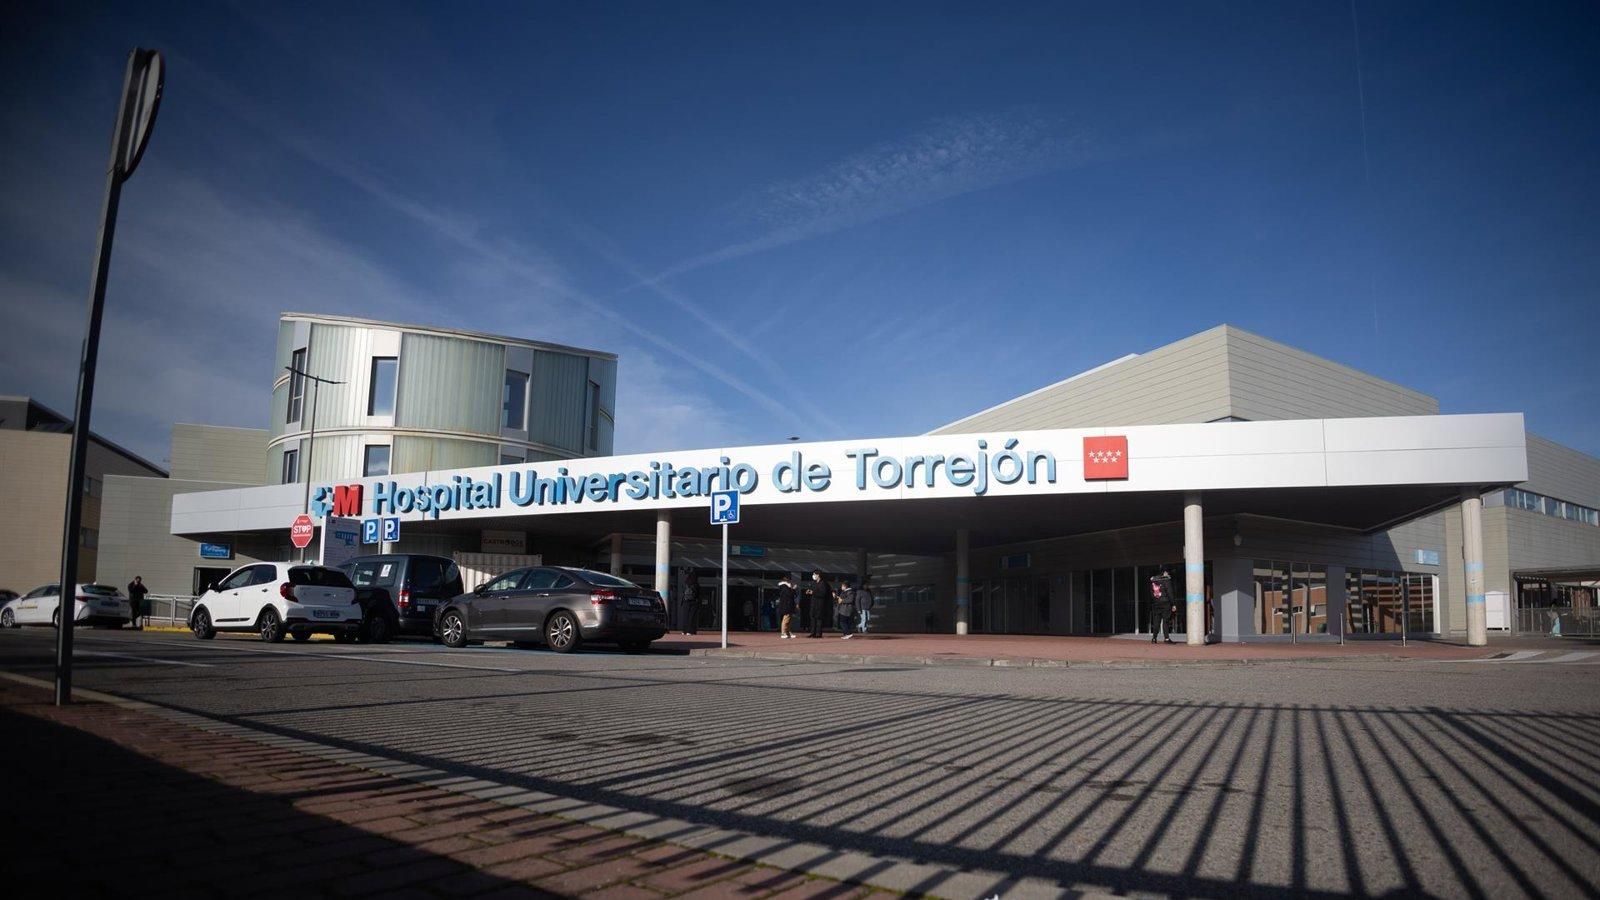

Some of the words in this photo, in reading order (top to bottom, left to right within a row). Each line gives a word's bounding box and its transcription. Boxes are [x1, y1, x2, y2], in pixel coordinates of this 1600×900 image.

[373, 472, 501, 518] Hospital
[509, 457, 759, 506] Universitario
[771, 450, 832, 493] de
[845, 438, 1056, 496] Torrejón
[714, 494, 732, 520] P
[293, 525, 312, 534] STOP
[366, 522, 376, 540] P
[384, 520, 395, 539] P
